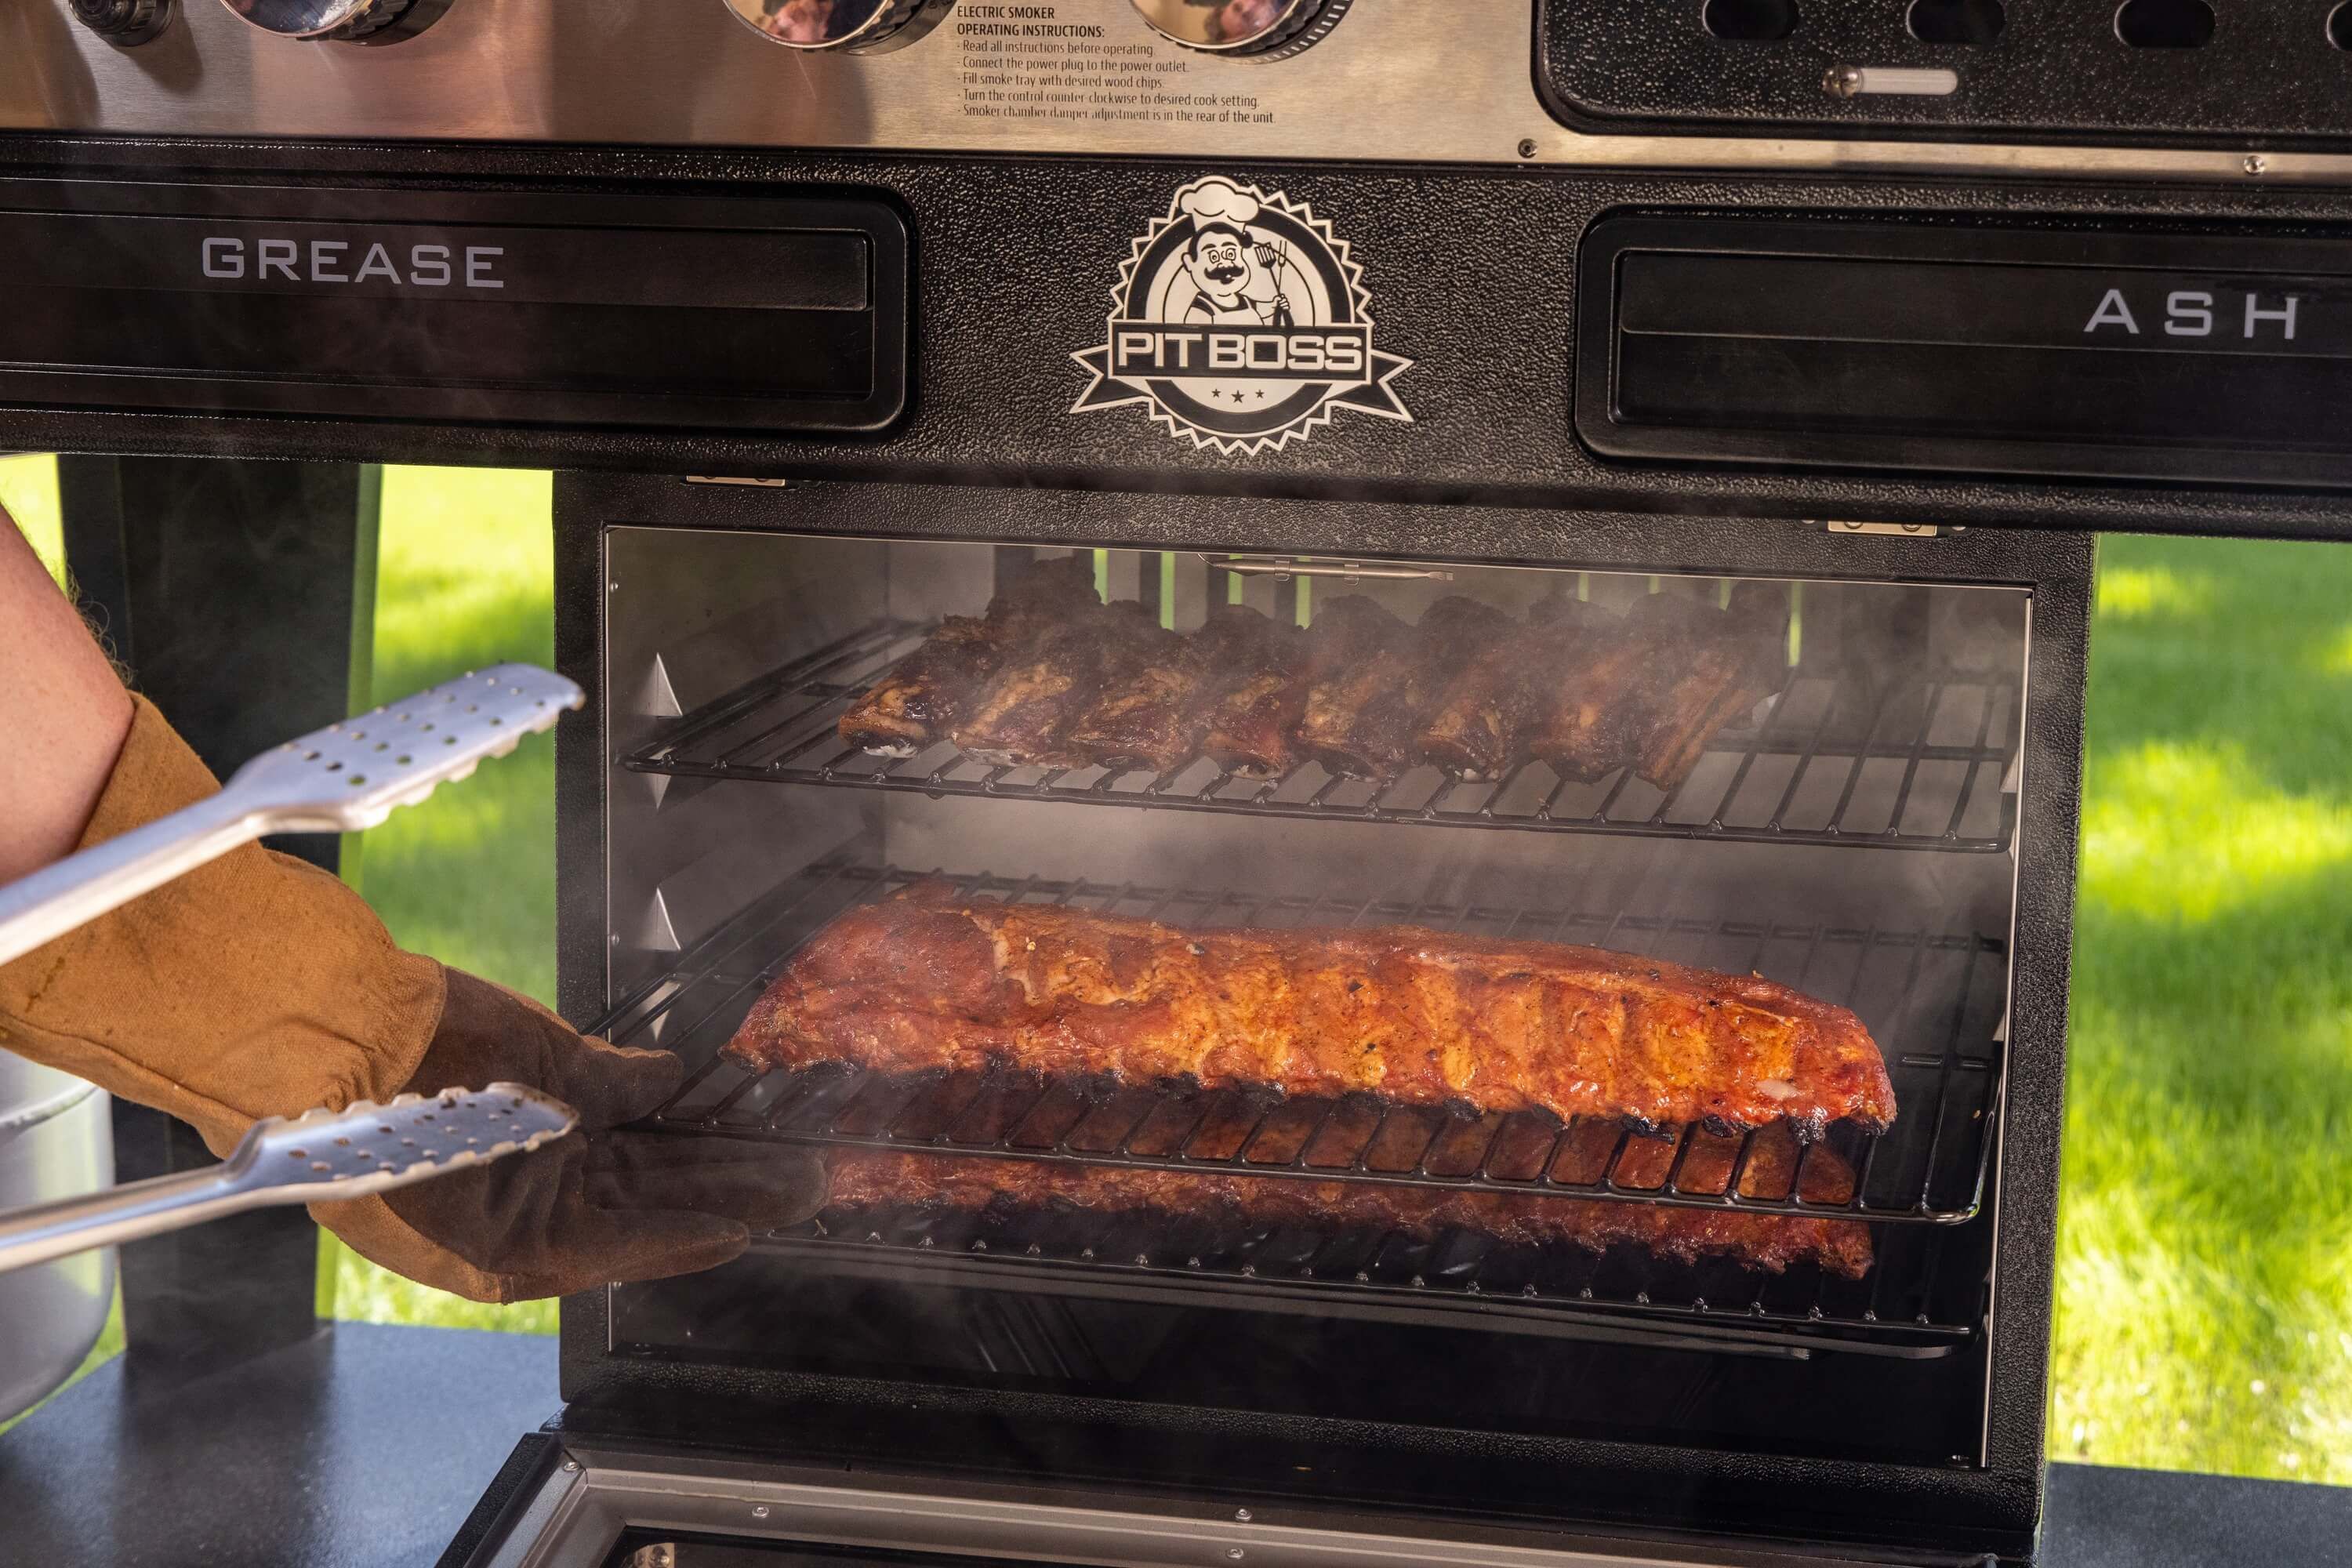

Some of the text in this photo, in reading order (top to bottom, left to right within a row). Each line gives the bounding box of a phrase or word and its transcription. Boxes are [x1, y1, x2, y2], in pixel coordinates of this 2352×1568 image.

[957, 6, 1054, 19] ELECTRIC SMOKER
[957, 24, 1105, 38] OPERATING INSTRUCTIONS:
[963, 40, 988, 52] Read
[990, 40, 1002, 52] all
[1005, 41, 1065, 53] instructions
[1068, 42, 1101, 53] before
[963, 56, 1003, 69] Connect
[1007, 56, 1023, 69] the
[1026, 60, 1058, 71] power
[1062, 59, 1083, 73] plug
[1087, 60, 1097, 71] to
[1101, 60, 1117, 71] the
[1120, 62, 1152, 73] power
[963, 72, 977, 85] Fill
[980, 74, 1012, 85] smoke
[1016, 74, 1036, 88] tray
[1039, 74, 1062, 86] with
[1065, 75, 1102, 87] desired
[1105, 76, 1132, 88] wood
[964, 89, 985, 101] Turn
[989, 89, 1005, 101] the
[1008, 90, 1043, 102] control
[1141, 94, 1151, 104] to
[1154, 93, 1191, 105] desired
[1194, 94, 1218, 106] cook
[1221, 96, 1260, 110] setting.
[963, 103, 1000, 117] Smoker
[1004, 105, 1046, 118] chamber
[1050, 107, 1087, 121] damper
[1092, 107, 1149, 121] adjustment
[1153, 110, 1161, 121] is
[1164, 110, 1173, 121] in
[1176, 110, 1193, 122] the
[1196, 112, 1215, 122] rear
[1218, 111, 1229, 122] of
[1233, 111, 1250, 123] the
[202, 238, 503, 288] GREASE
[2084, 289, 2298, 339] ASH
[1118, 332, 1363, 372] PIT BOSS
